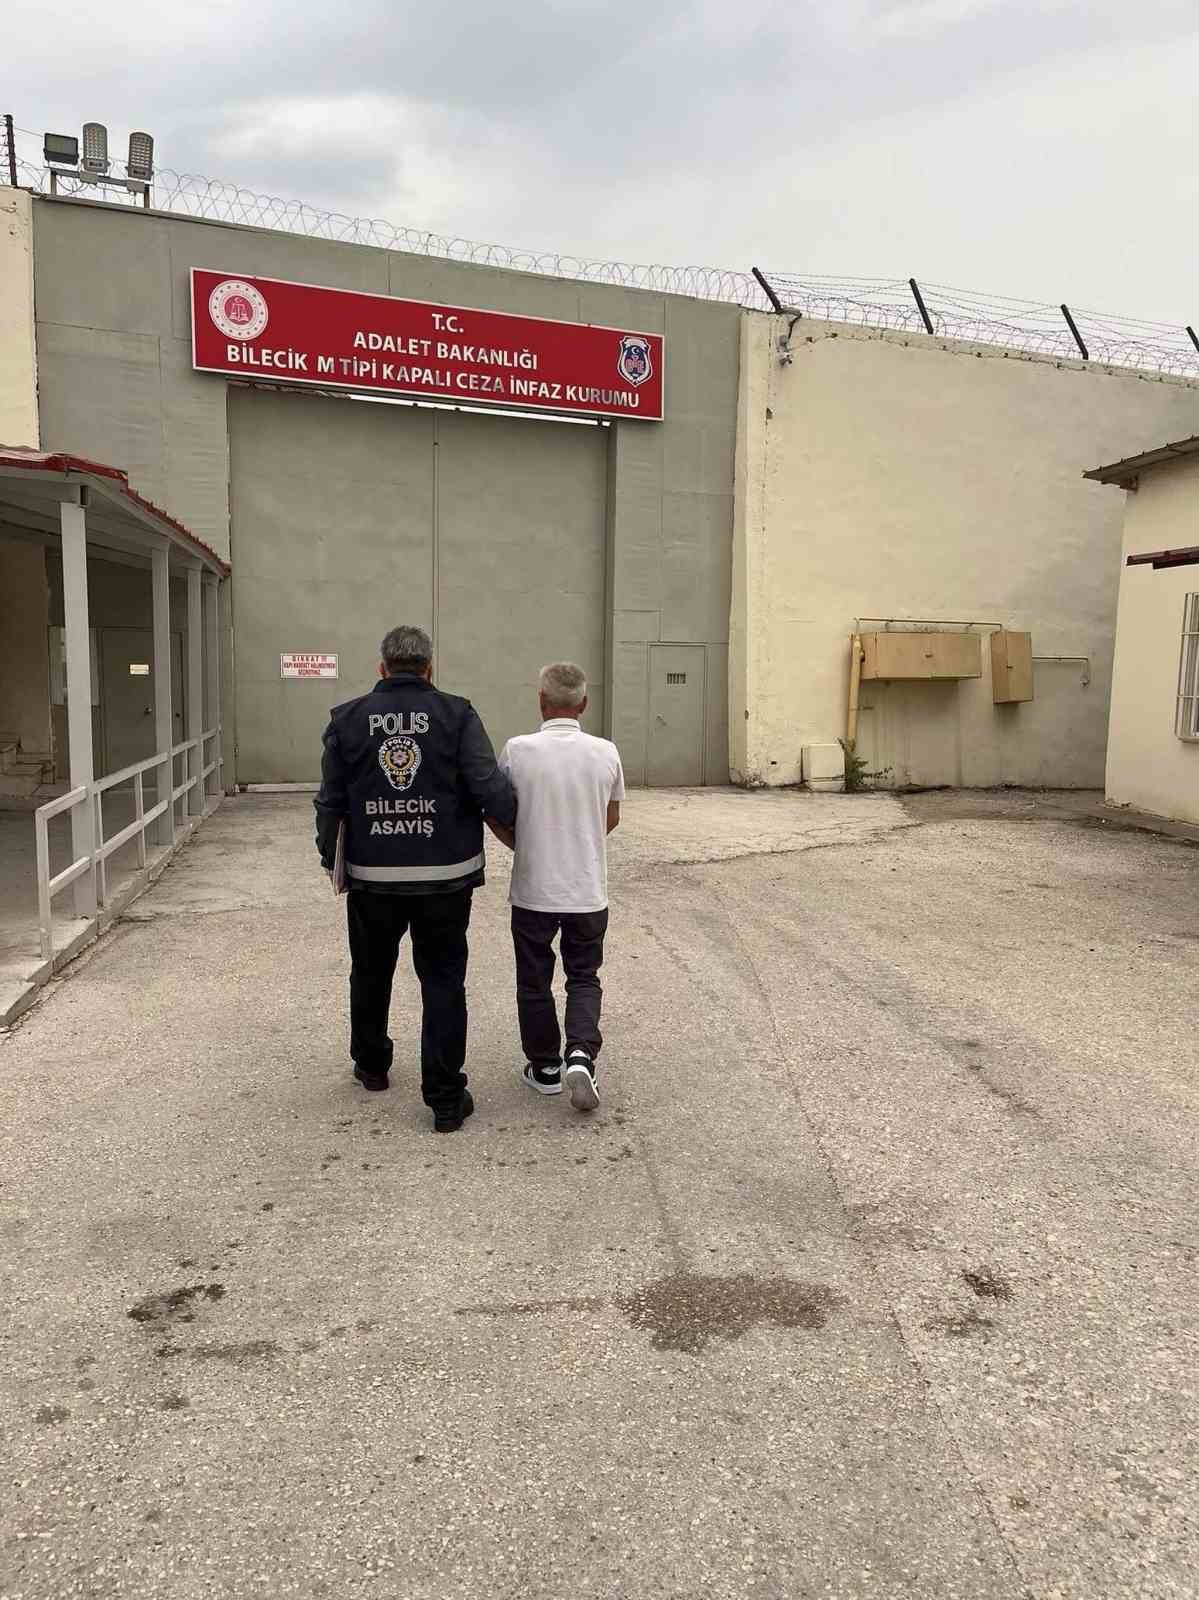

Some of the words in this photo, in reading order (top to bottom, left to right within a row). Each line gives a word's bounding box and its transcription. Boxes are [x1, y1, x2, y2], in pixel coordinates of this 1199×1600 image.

[431, 313, 465, 333] T.C.
[353, 331, 431, 357] ADALET
[436, 342, 538, 370] BAKANLIĞI
[226, 343, 308, 371] BİLECİK
[316, 355, 335, 374] M
[338, 356, 377, 379] TİPİ
[382, 363, 451, 387] KAPALI
[456, 372, 505, 393] CEZA
[510, 375, 562, 400] İNFAZ
[566, 385, 640, 408] KURUMU
[365, 796, 437, 815] BİLECİK
[369, 816, 435, 838] ASAYİŞ
